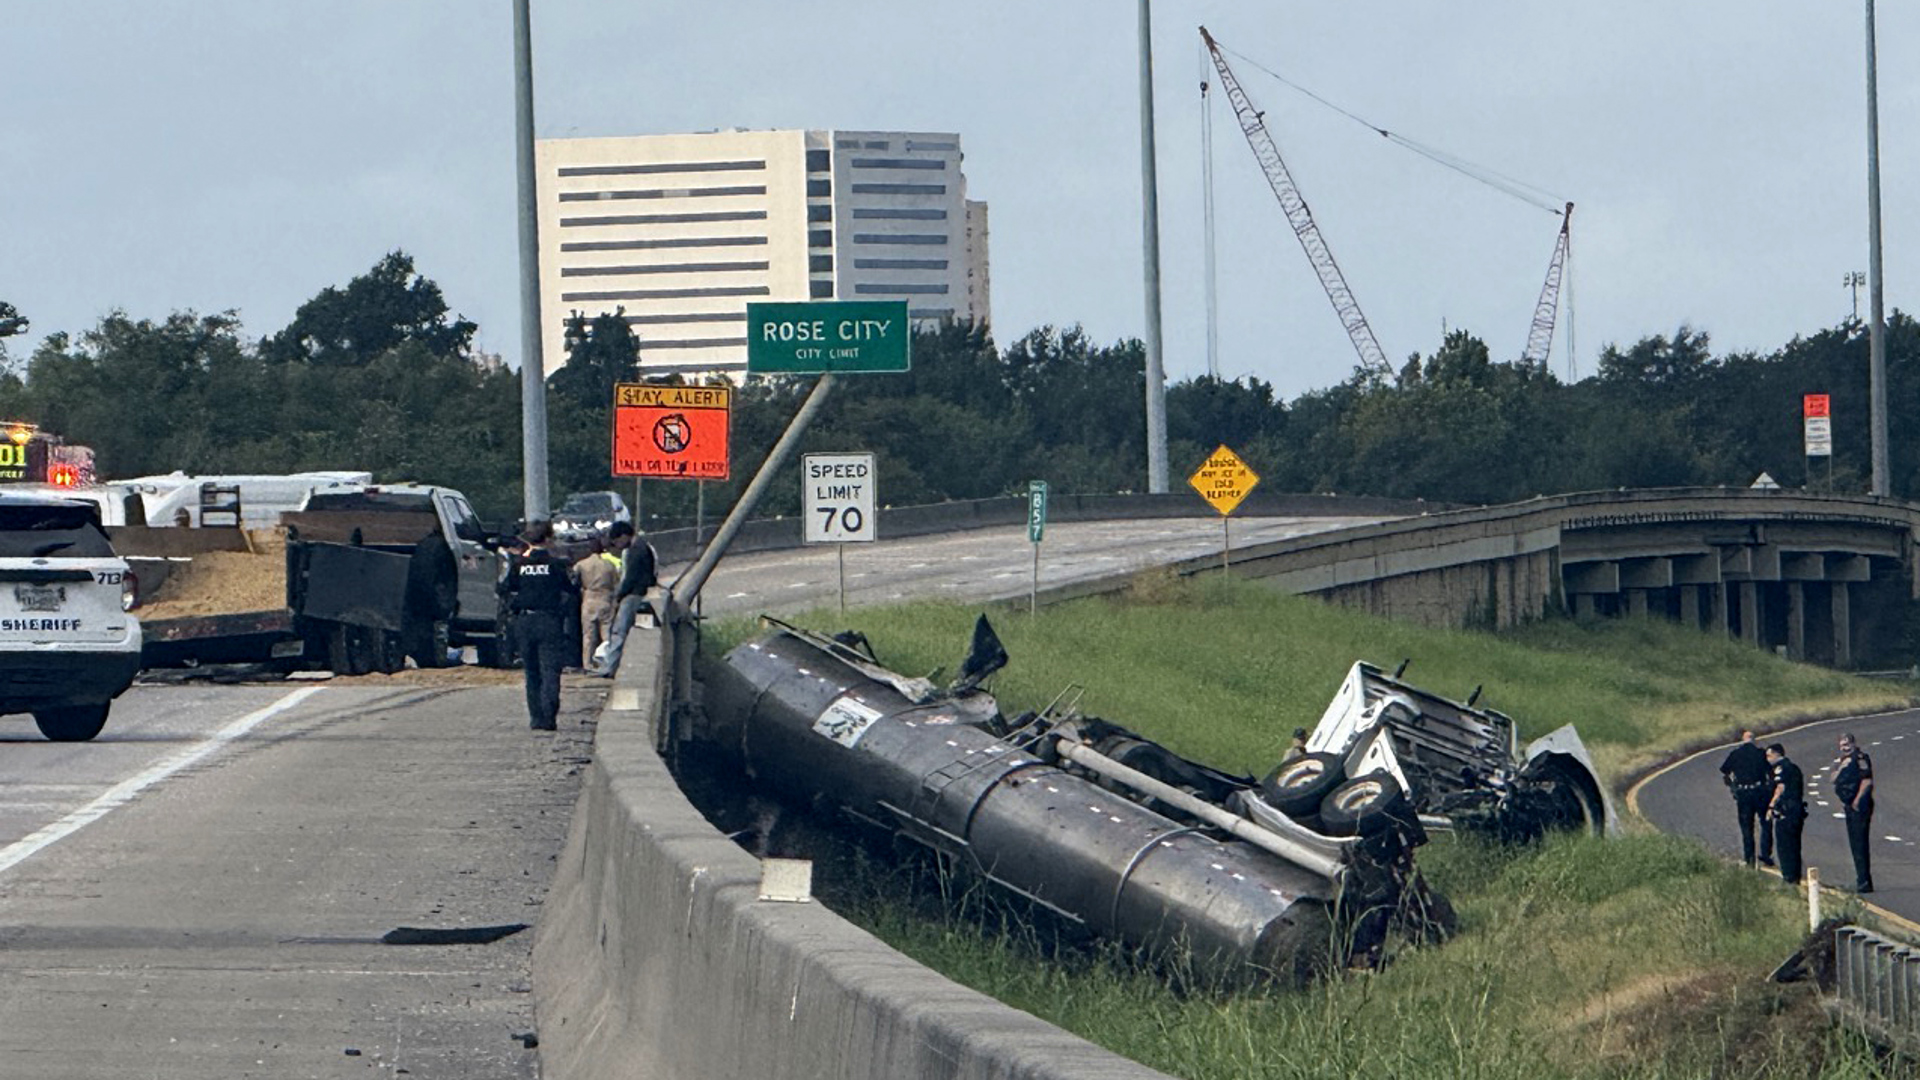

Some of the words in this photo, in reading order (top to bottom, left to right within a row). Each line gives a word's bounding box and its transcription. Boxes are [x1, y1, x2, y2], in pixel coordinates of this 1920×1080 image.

[763, 321, 826, 341] ROSE
[838, 320, 891, 340] CITY
[796, 348, 822, 359] CITY
[829, 348, 859, 359] LIMIT
[623, 388, 661, 404] STAY
[674, 391, 722, 404] ALERT
[811, 464, 868, 478] SPEED
[817, 485, 862, 500] LIMIT
[816, 507, 863, 533] 70
[520, 564, 550, 576] POLICE
[97, 572, 121, 585] 713
[1, 619, 82, 631] SHERIFF
